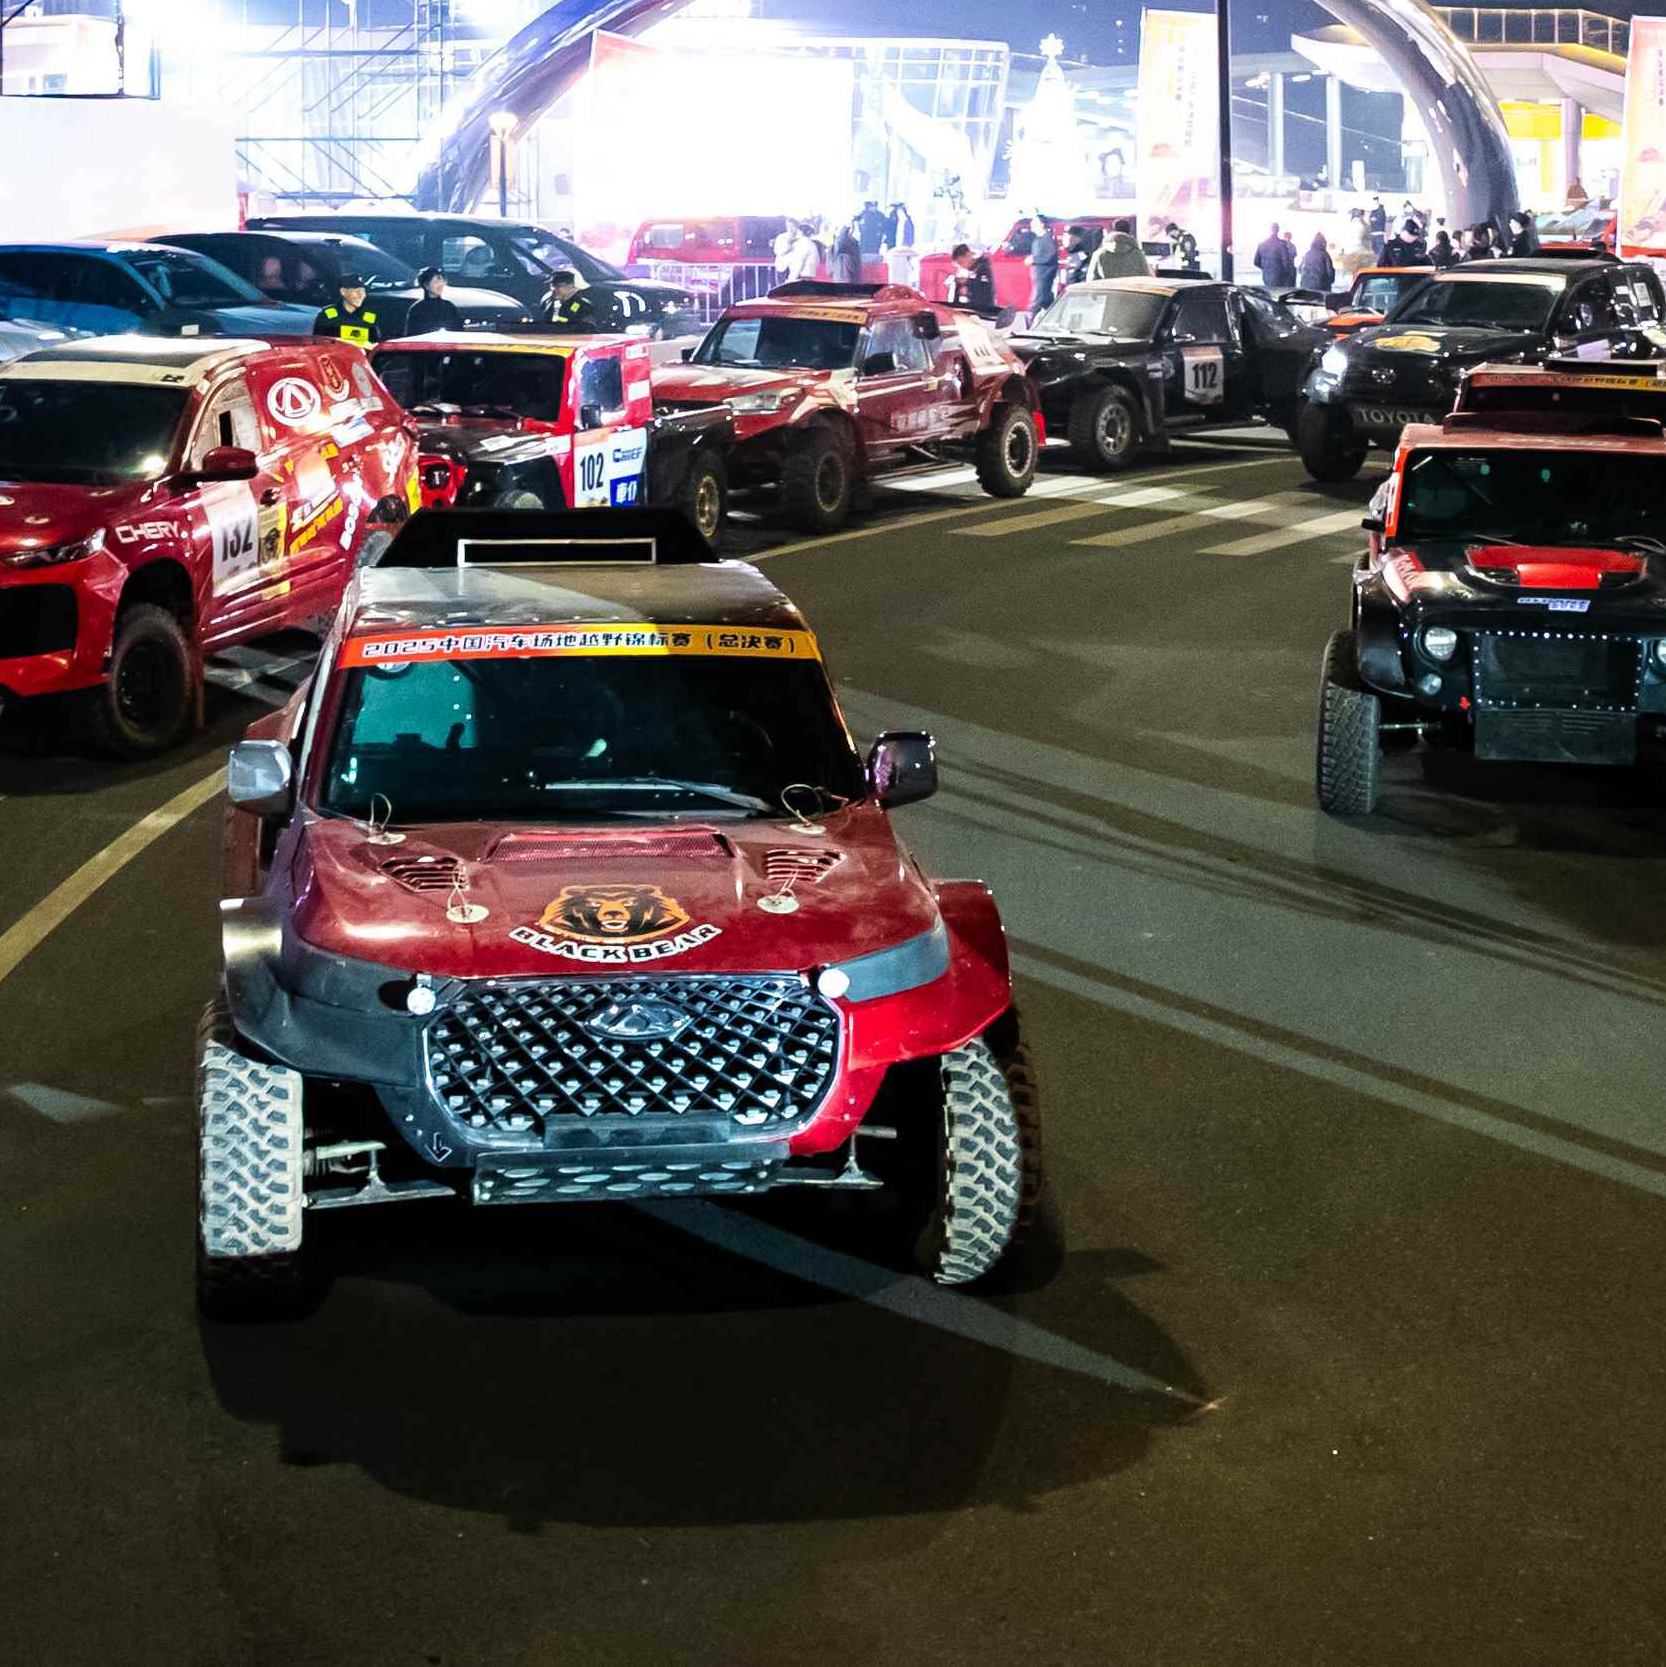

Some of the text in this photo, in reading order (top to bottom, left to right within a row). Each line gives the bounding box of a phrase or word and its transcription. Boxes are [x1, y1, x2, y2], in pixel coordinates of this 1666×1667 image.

[1191, 361, 1219, 389] 112
[1356, 406, 1437, 426] TOYOTA
[579, 451, 605, 492] 102
[113, 519, 182, 545] CHERY
[220, 519, 255, 563] 132
[509, 924, 722, 963] BLACK BEAR
